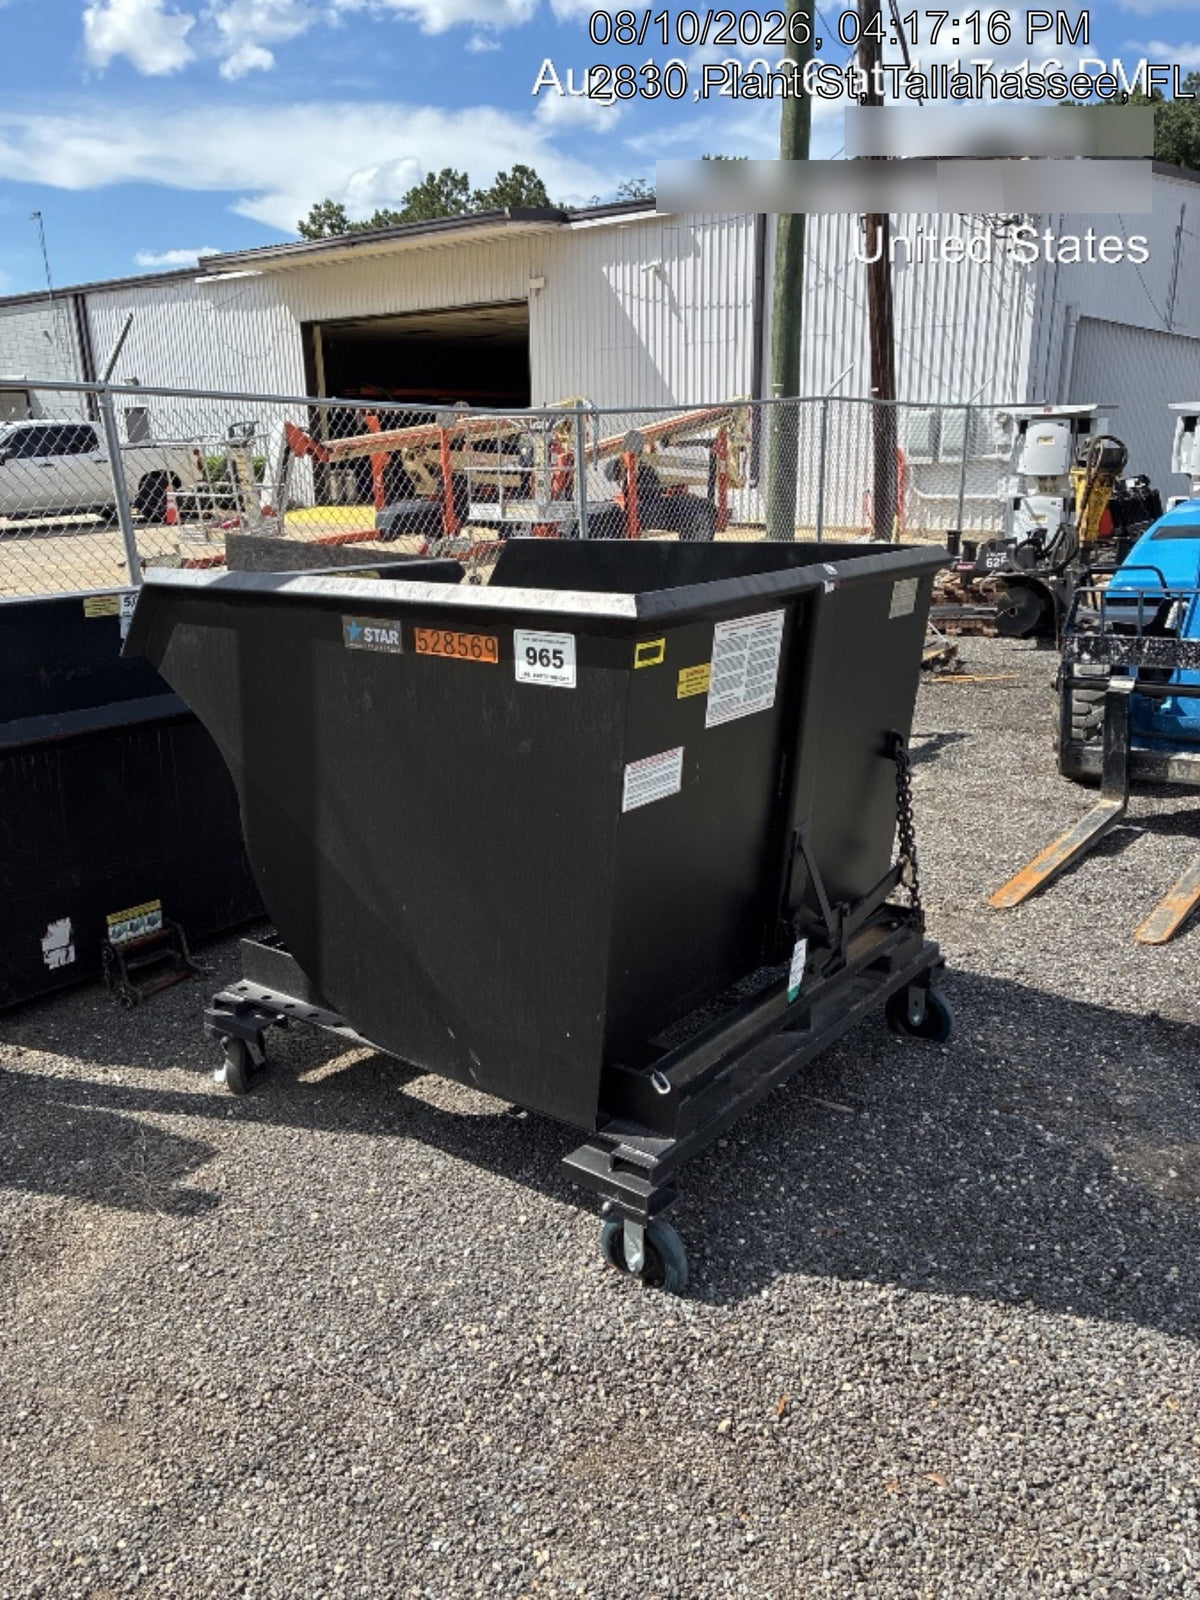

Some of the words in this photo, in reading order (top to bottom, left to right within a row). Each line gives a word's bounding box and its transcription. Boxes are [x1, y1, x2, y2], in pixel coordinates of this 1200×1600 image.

[363, 626, 399, 645] STAR
[417, 630, 497, 662] 528569
[525, 646, 564, 669] 965
